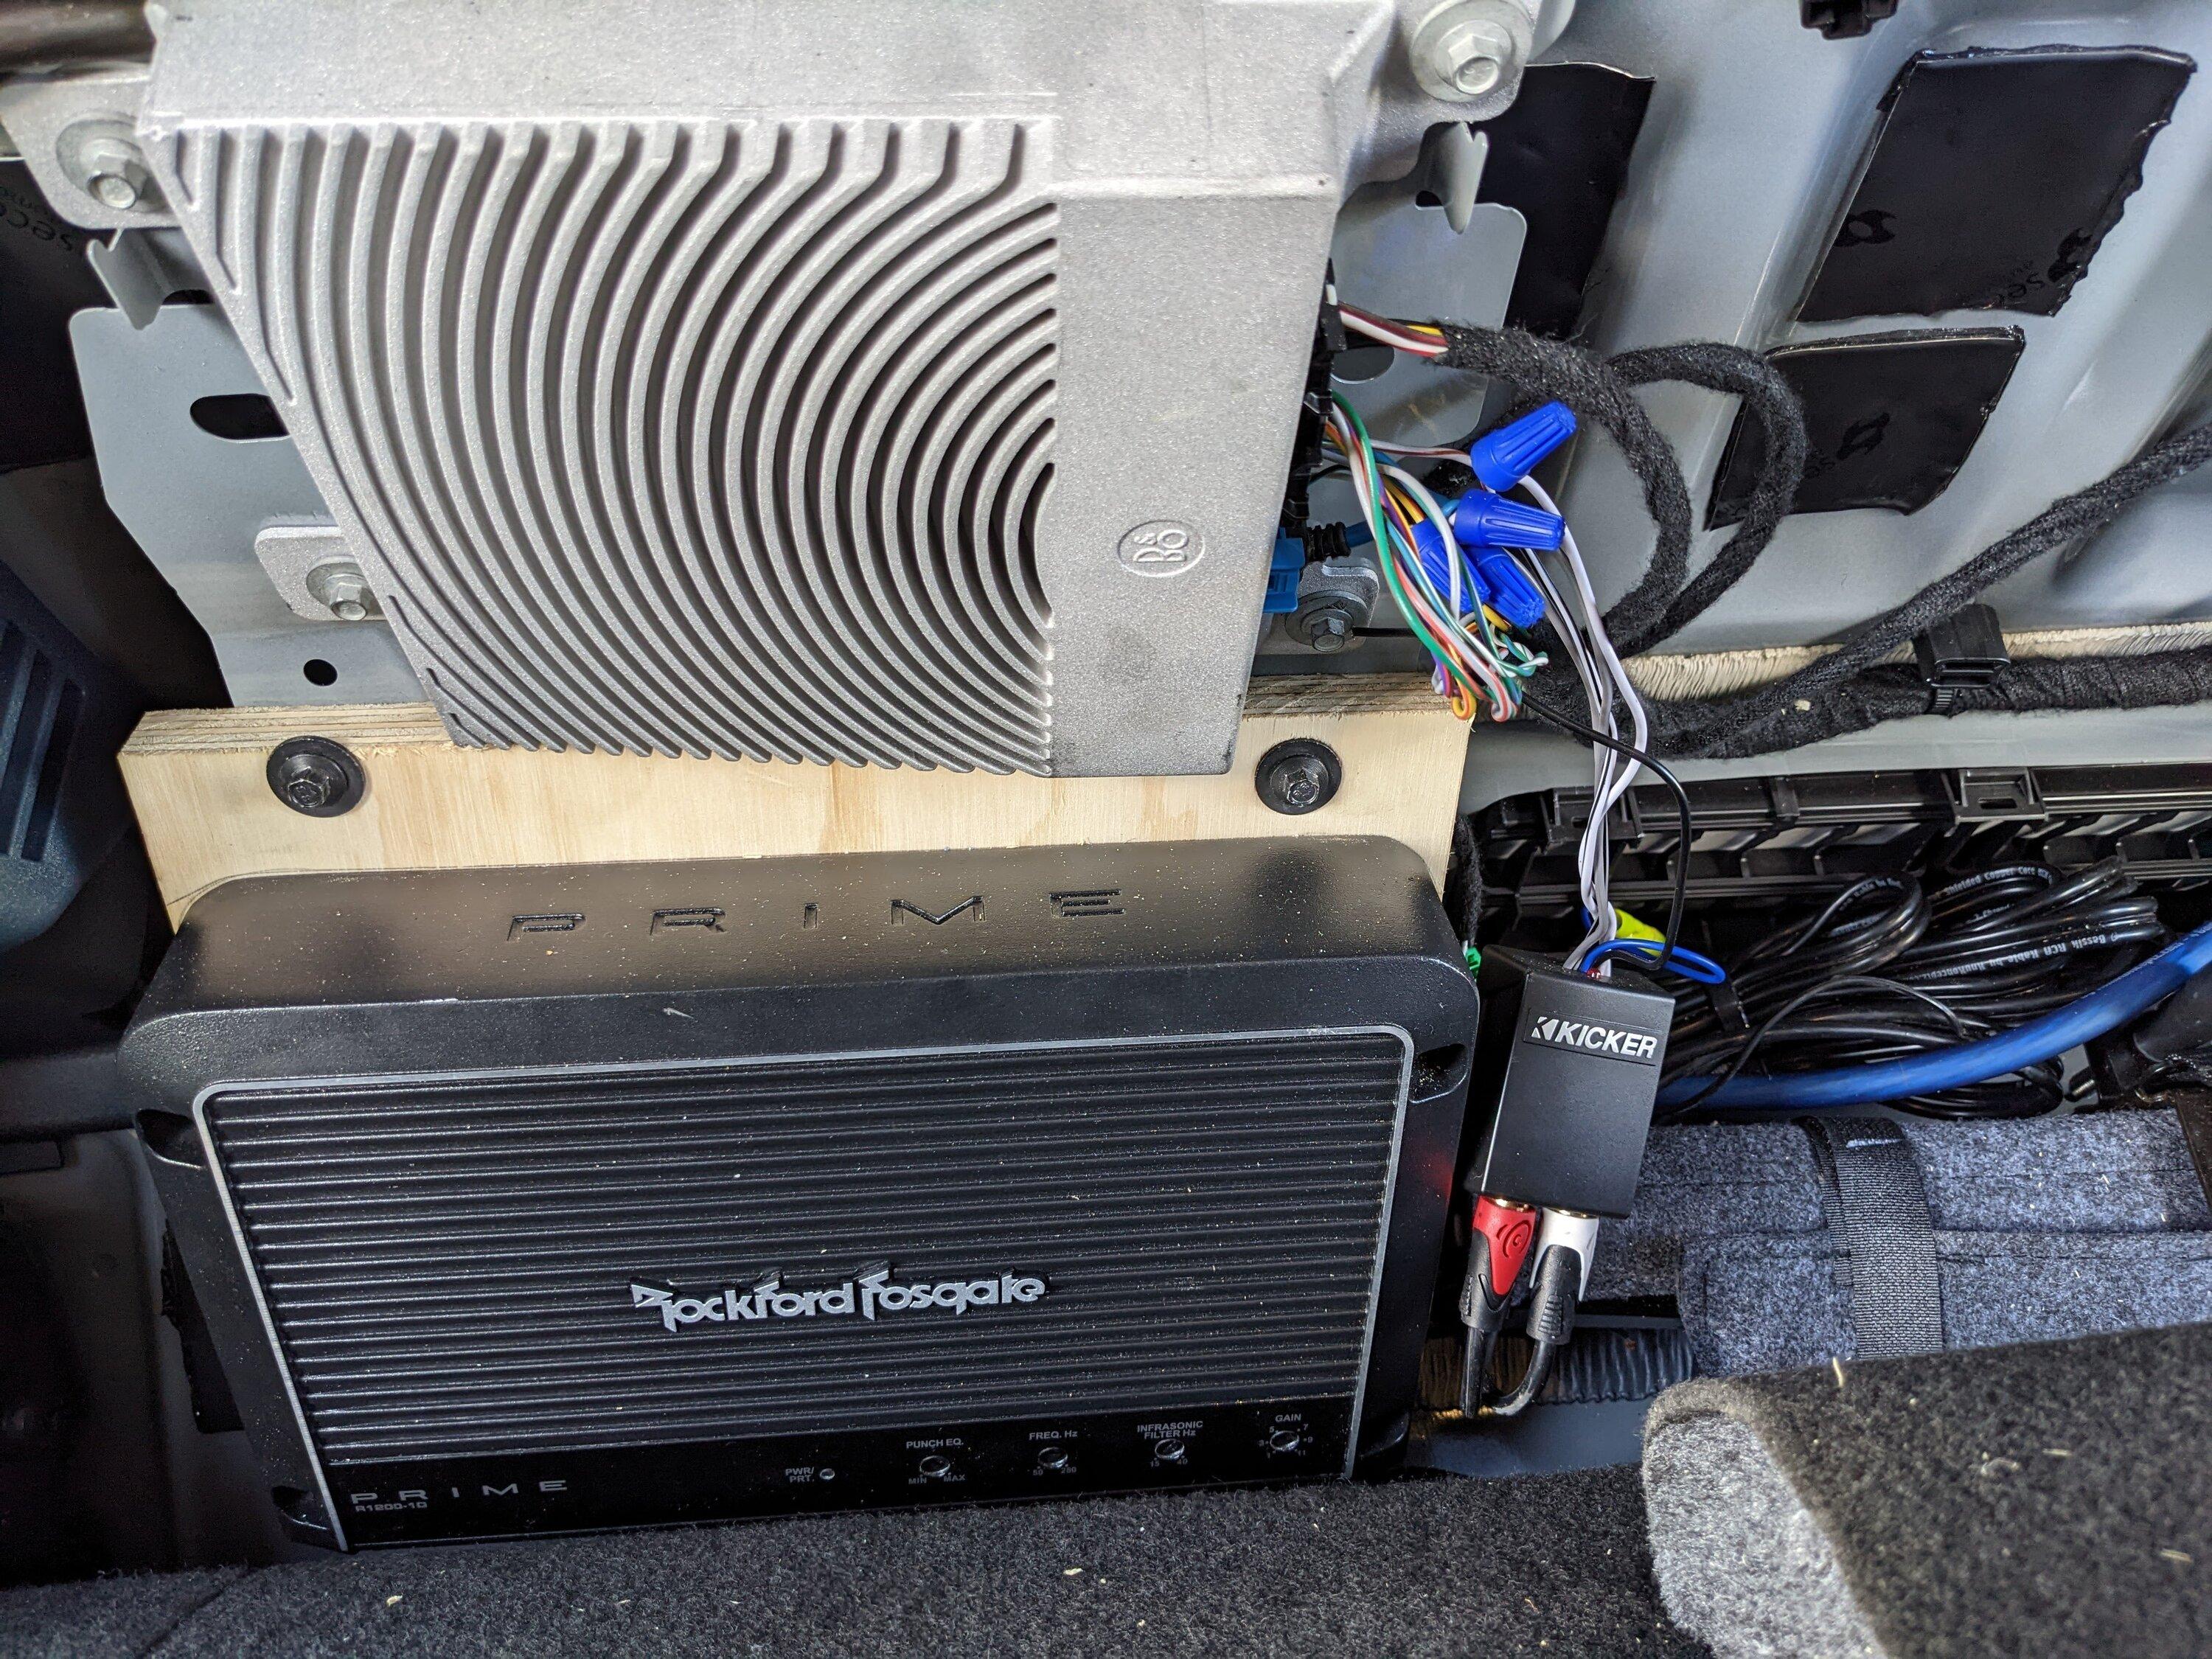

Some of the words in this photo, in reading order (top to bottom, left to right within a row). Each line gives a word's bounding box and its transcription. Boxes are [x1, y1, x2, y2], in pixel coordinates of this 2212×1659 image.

[506, 888, 1127, 942] PRIME
[2071, 934, 2106, 949] Bassik
[2043, 942, 2067, 956] RCA
[2007, 949, 2039, 964] Kable
[1554, 1020, 1658, 1060] KICKER
[630, 1281, 856, 1332] Rockford
[858, 1270, 1046, 1321] Fosgate
[1275, 1413, 1301, 1422] GAIN
[1137, 1420, 1203, 1433] INFRASONIC
[1029, 1432, 1062, 1440] FREQ.
[1064, 1430, 1078, 1438] Hz
[1144, 1429, 1180, 1439] FILTER
[1183, 1429, 1196, 1437] Hz
[906, 1439, 944, 1449] PUNCH
[945, 1437, 964, 1447] EQ.
[785, 1467, 815, 1475] PWR/
[790, 1474, 815, 1483] PRT.
[908, 1477, 928, 1485] MIN
[943, 1474, 966, 1482] MAX
[351, 1479, 568, 1504] PRIME
